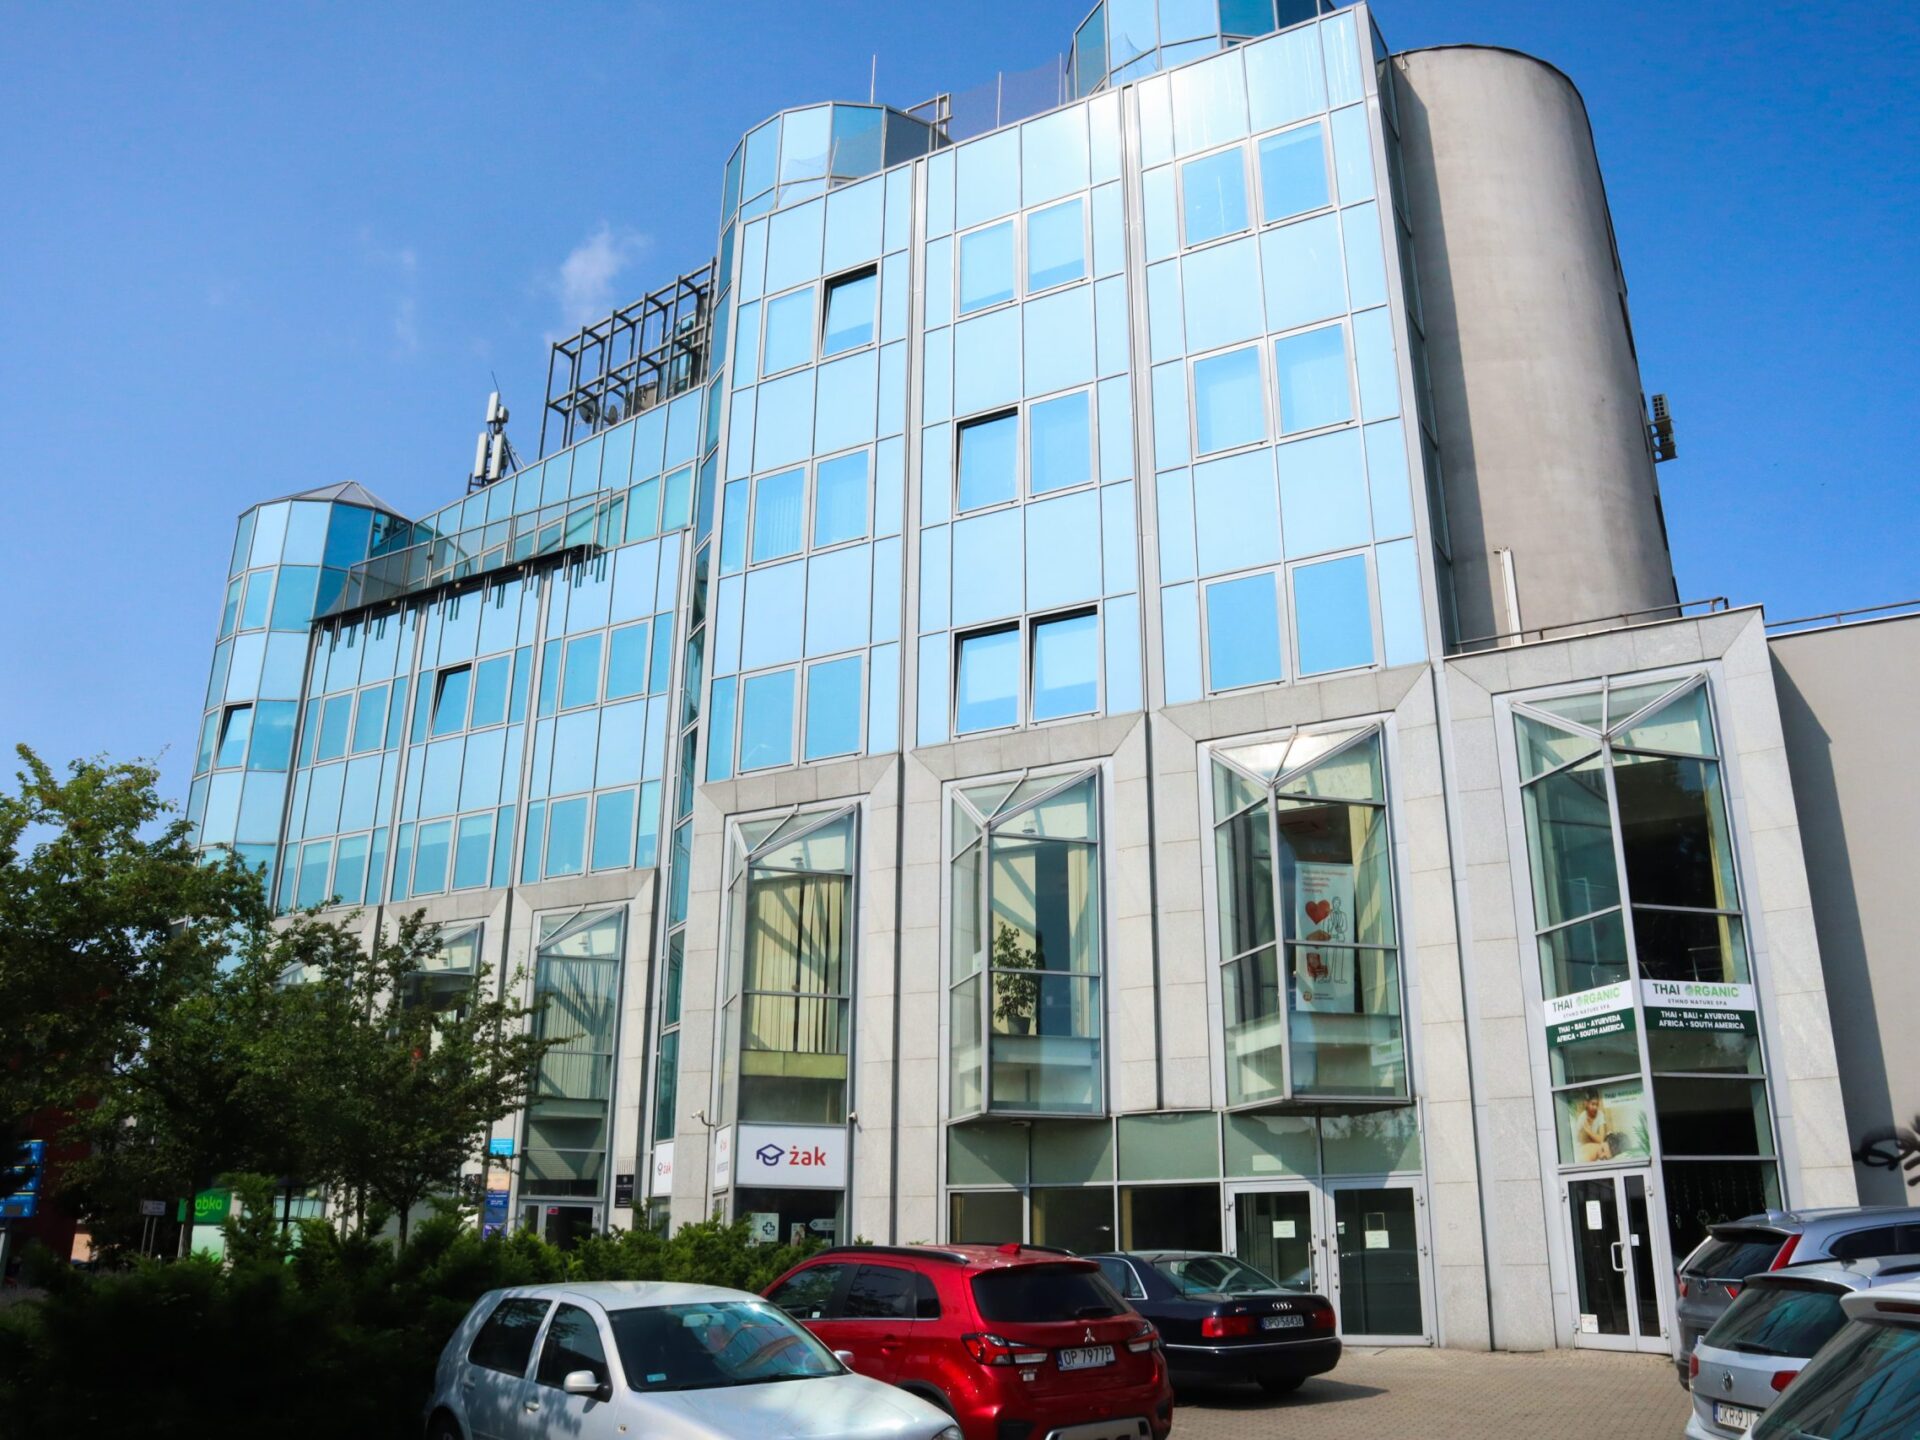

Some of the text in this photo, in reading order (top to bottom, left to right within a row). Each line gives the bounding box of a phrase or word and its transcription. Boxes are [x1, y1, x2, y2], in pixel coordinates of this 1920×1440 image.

[1552, 987, 1621, 1012] THAI ORGANIC
[1653, 983, 1739, 998] THAI ORGANIC
[1580, 1007, 1599, 1015] NATURE
[1660, 1010, 1740, 1020] THAI BALI AYURVEDA
[1556, 1023, 1625, 1043] AFRICA SOUTH AMERICA
[1558, 1014, 1621, 1034] THAI BALI AYURVEDA
[1659, 1019, 1745, 1030] AFRICA SOUTH AMERICA
[789, 1145, 827, 1166] żak
[1063, 1347, 1112, 1365] OP 7977P
